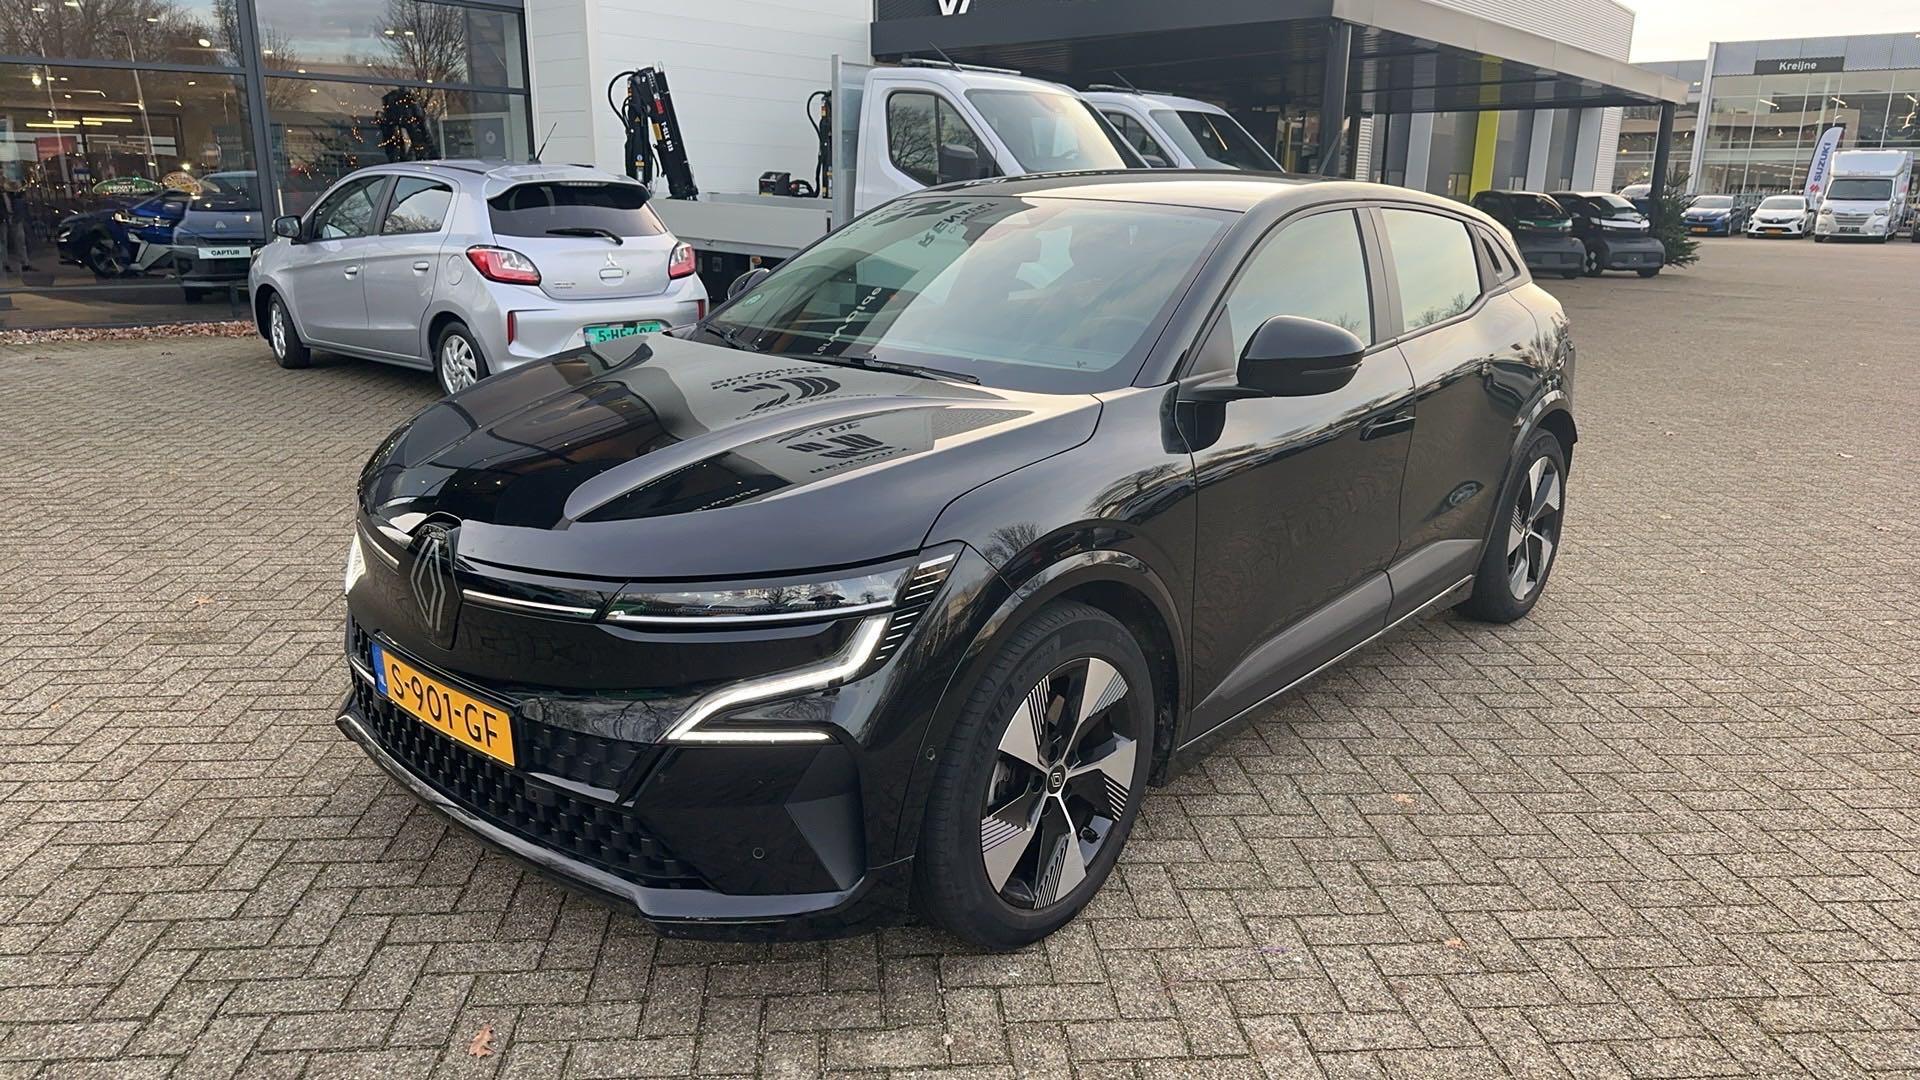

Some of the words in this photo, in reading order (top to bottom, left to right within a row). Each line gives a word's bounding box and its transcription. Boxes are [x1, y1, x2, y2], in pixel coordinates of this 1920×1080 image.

[1778, 61, 1817, 71] Kreijne
[1814, 142, 1832, 182] SUZUKI
[210, 249, 240, 257] CAPTUR
[391, 663, 498, 748] S-901-GF
